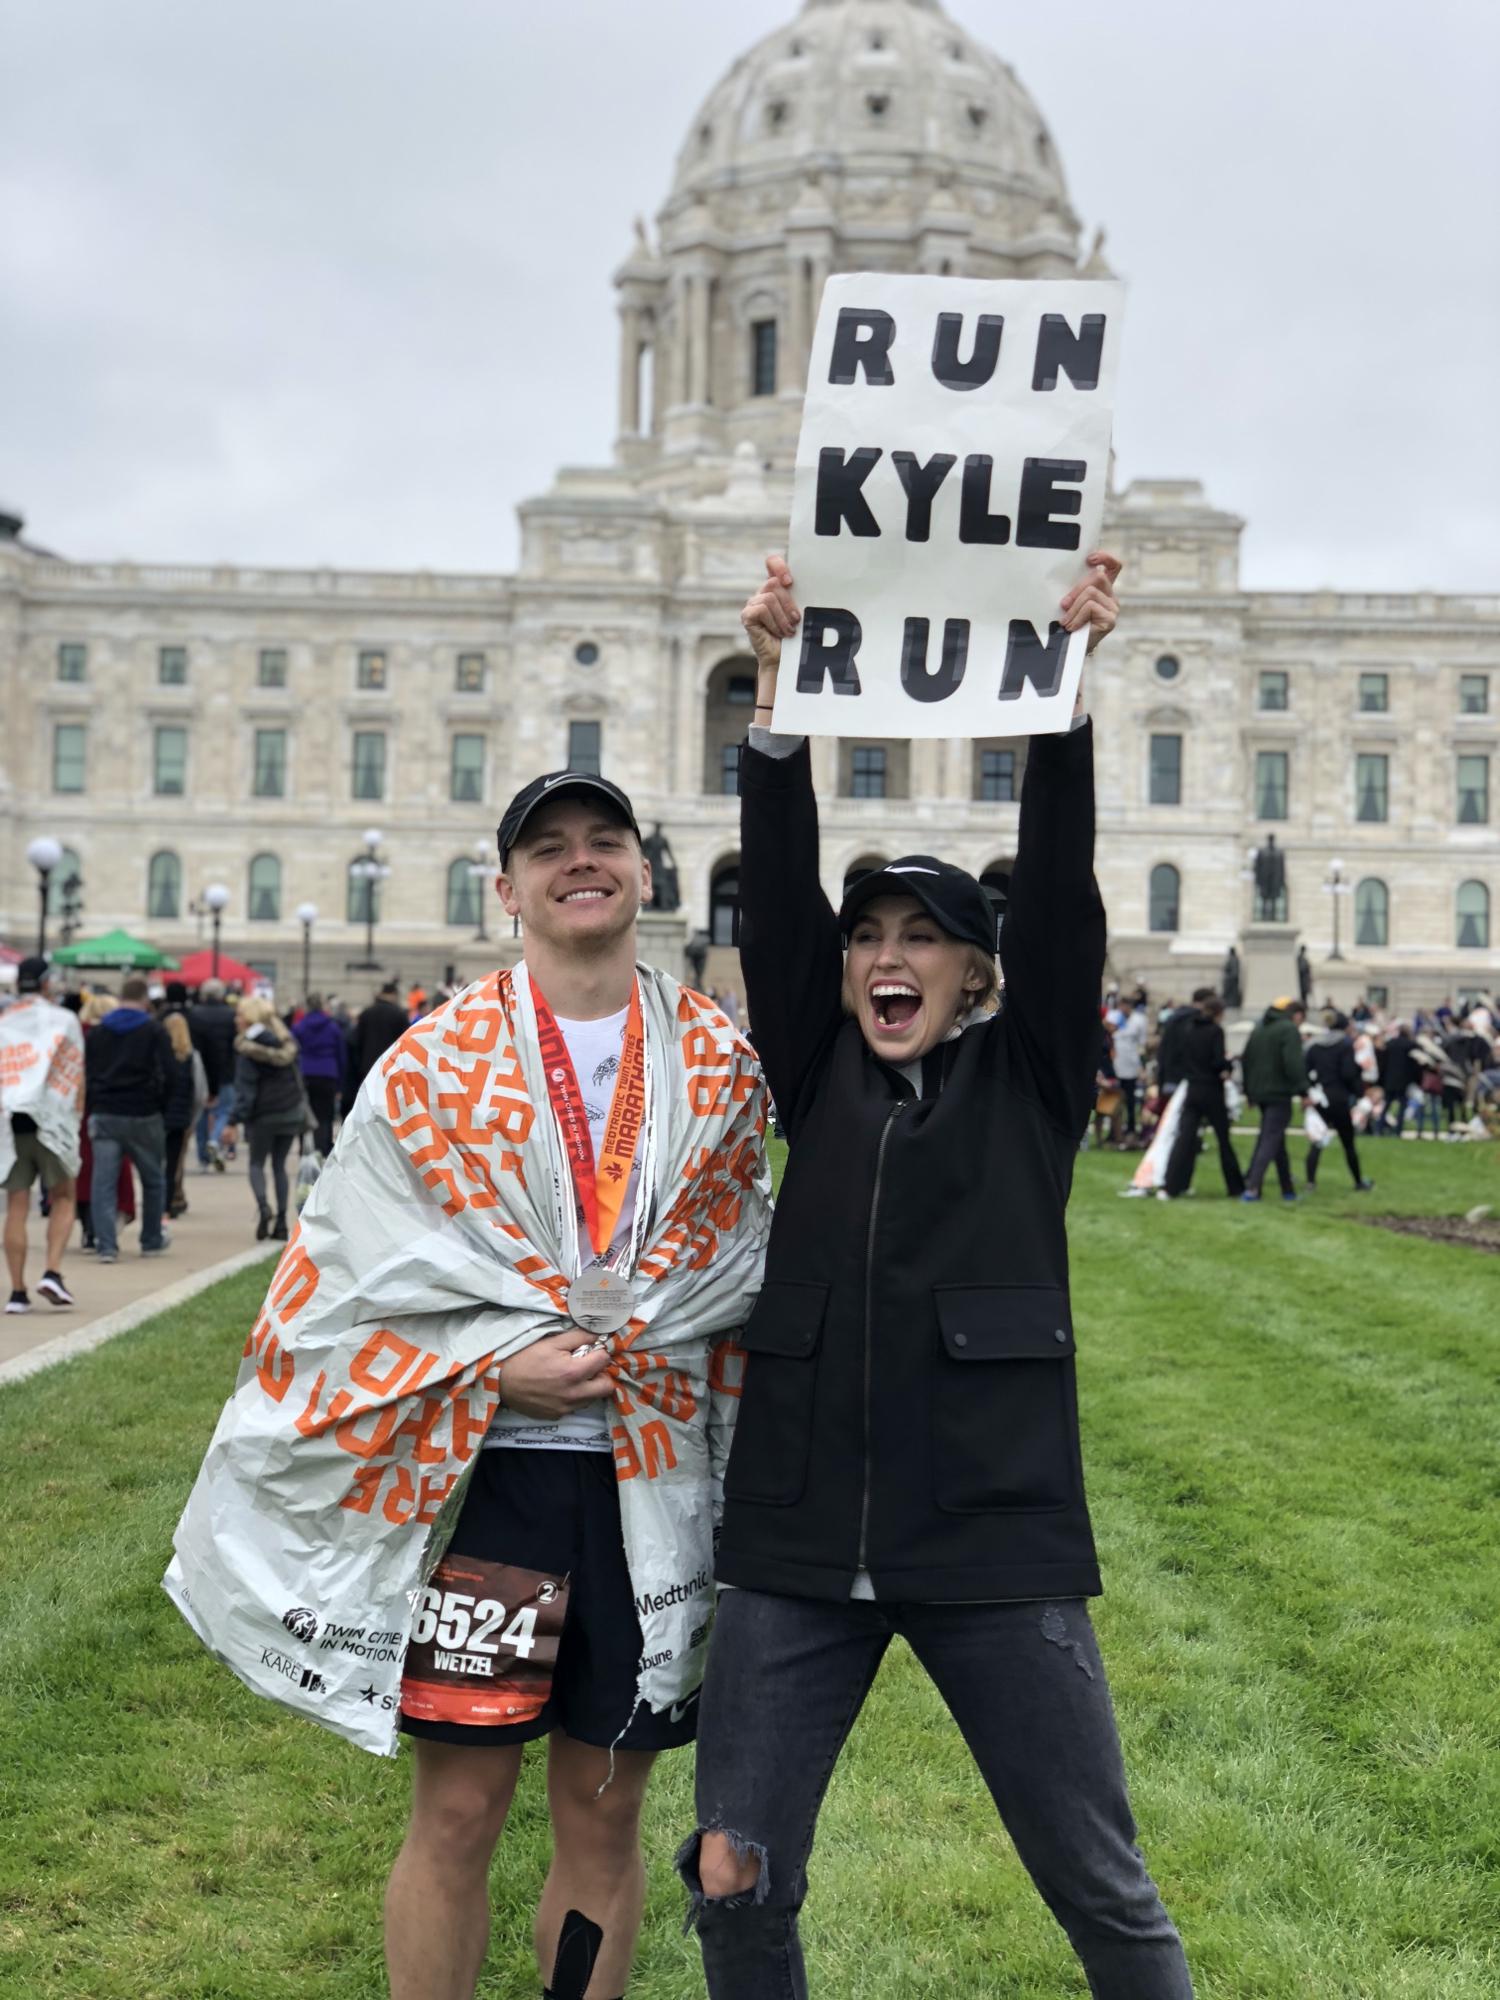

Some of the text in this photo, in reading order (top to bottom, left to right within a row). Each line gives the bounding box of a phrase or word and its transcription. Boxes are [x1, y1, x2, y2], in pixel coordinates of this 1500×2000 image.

[827, 307, 1106, 392] RUN
[814, 446, 1087, 551] KYLE
[796, 606, 1071, 703] RUN
[560, 1084, 568, 1101] TWIN
[565, 1102, 575, 1122] CITIES
[575, 1133, 585, 1161] MOTION
[605, 1034, 636, 1155] MEDTRONIC TWIN CITIES
[539, 1584, 554, 1602] 2
[637, 1571, 709, 1616] Medtrnic
[320, 1639, 400, 1663] IN MOTION
[323, 1623, 403, 1645] TWIN CITIE
[410, 1587, 538, 1659] 6524
[261, 1649, 301, 1682] KARE
[433, 1650, 494, 1677] WETZEL
